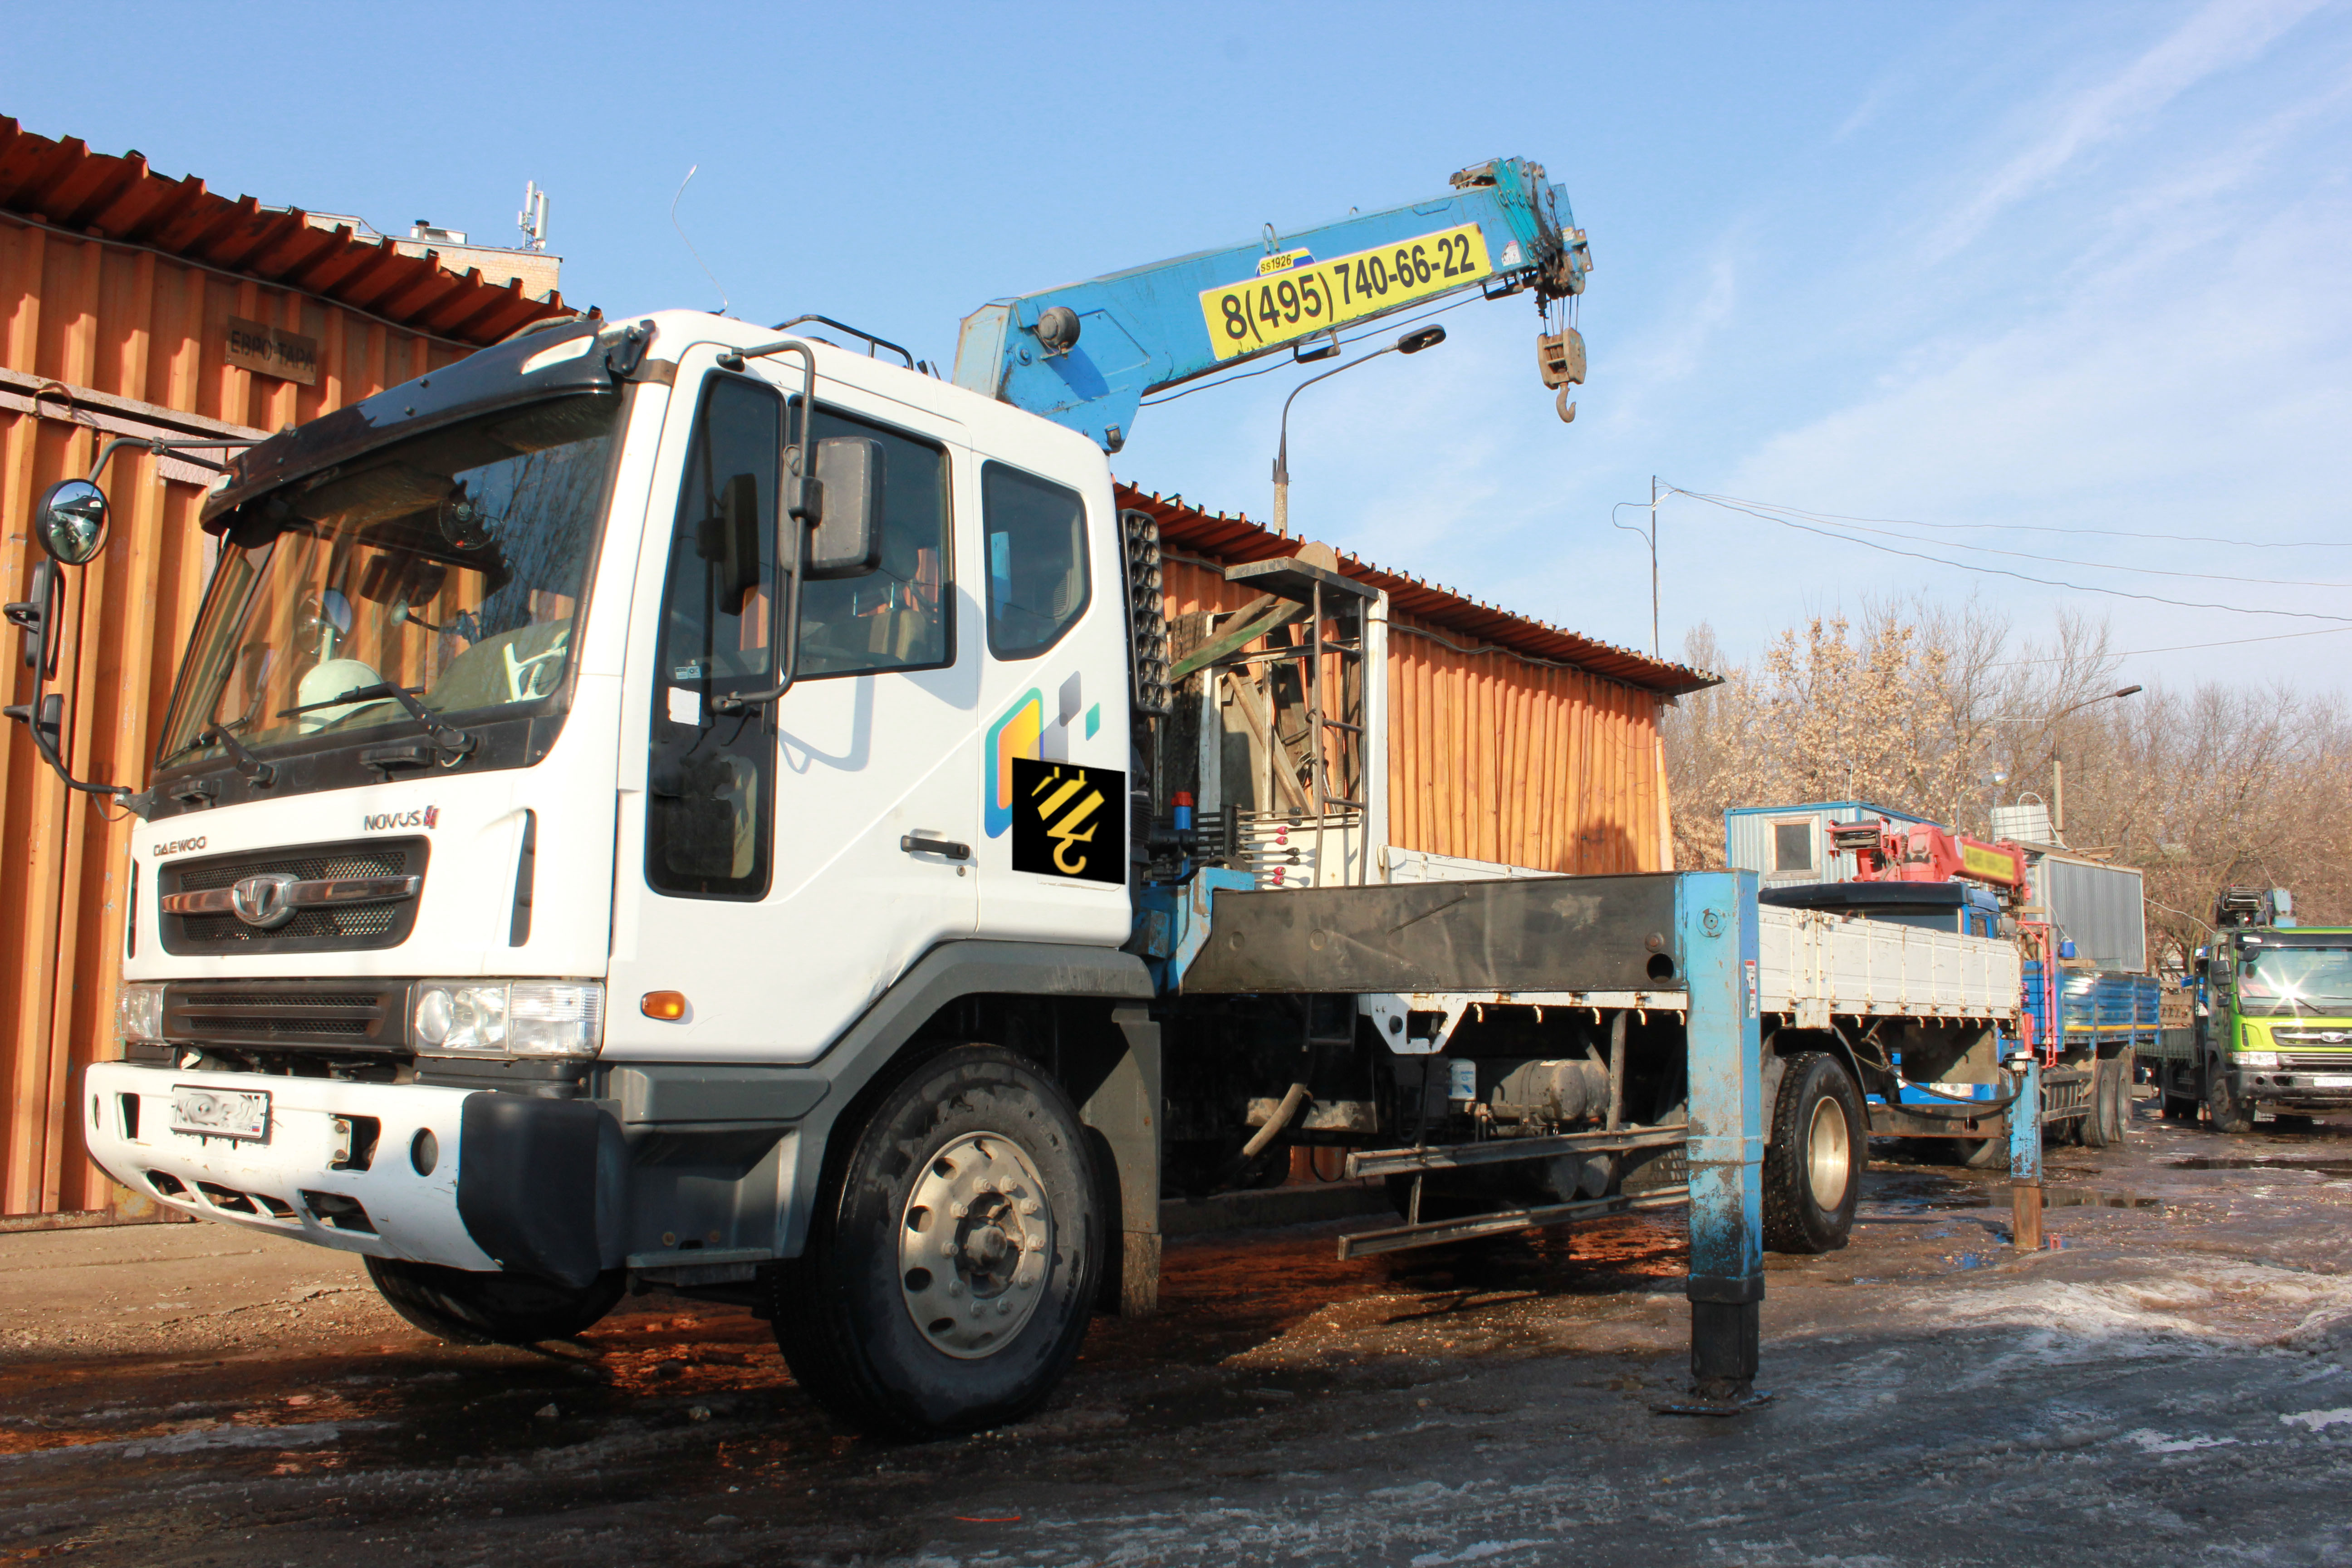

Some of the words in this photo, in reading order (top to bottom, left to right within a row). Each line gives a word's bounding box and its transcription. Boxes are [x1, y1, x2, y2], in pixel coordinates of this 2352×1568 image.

[1221, 272, 1334, 343] 8(495)
[1333, 233, 1476, 305] 740-66-22
[364, 809, 422, 831] NOVUS
[153, 835, 207, 857] DAEWOO
